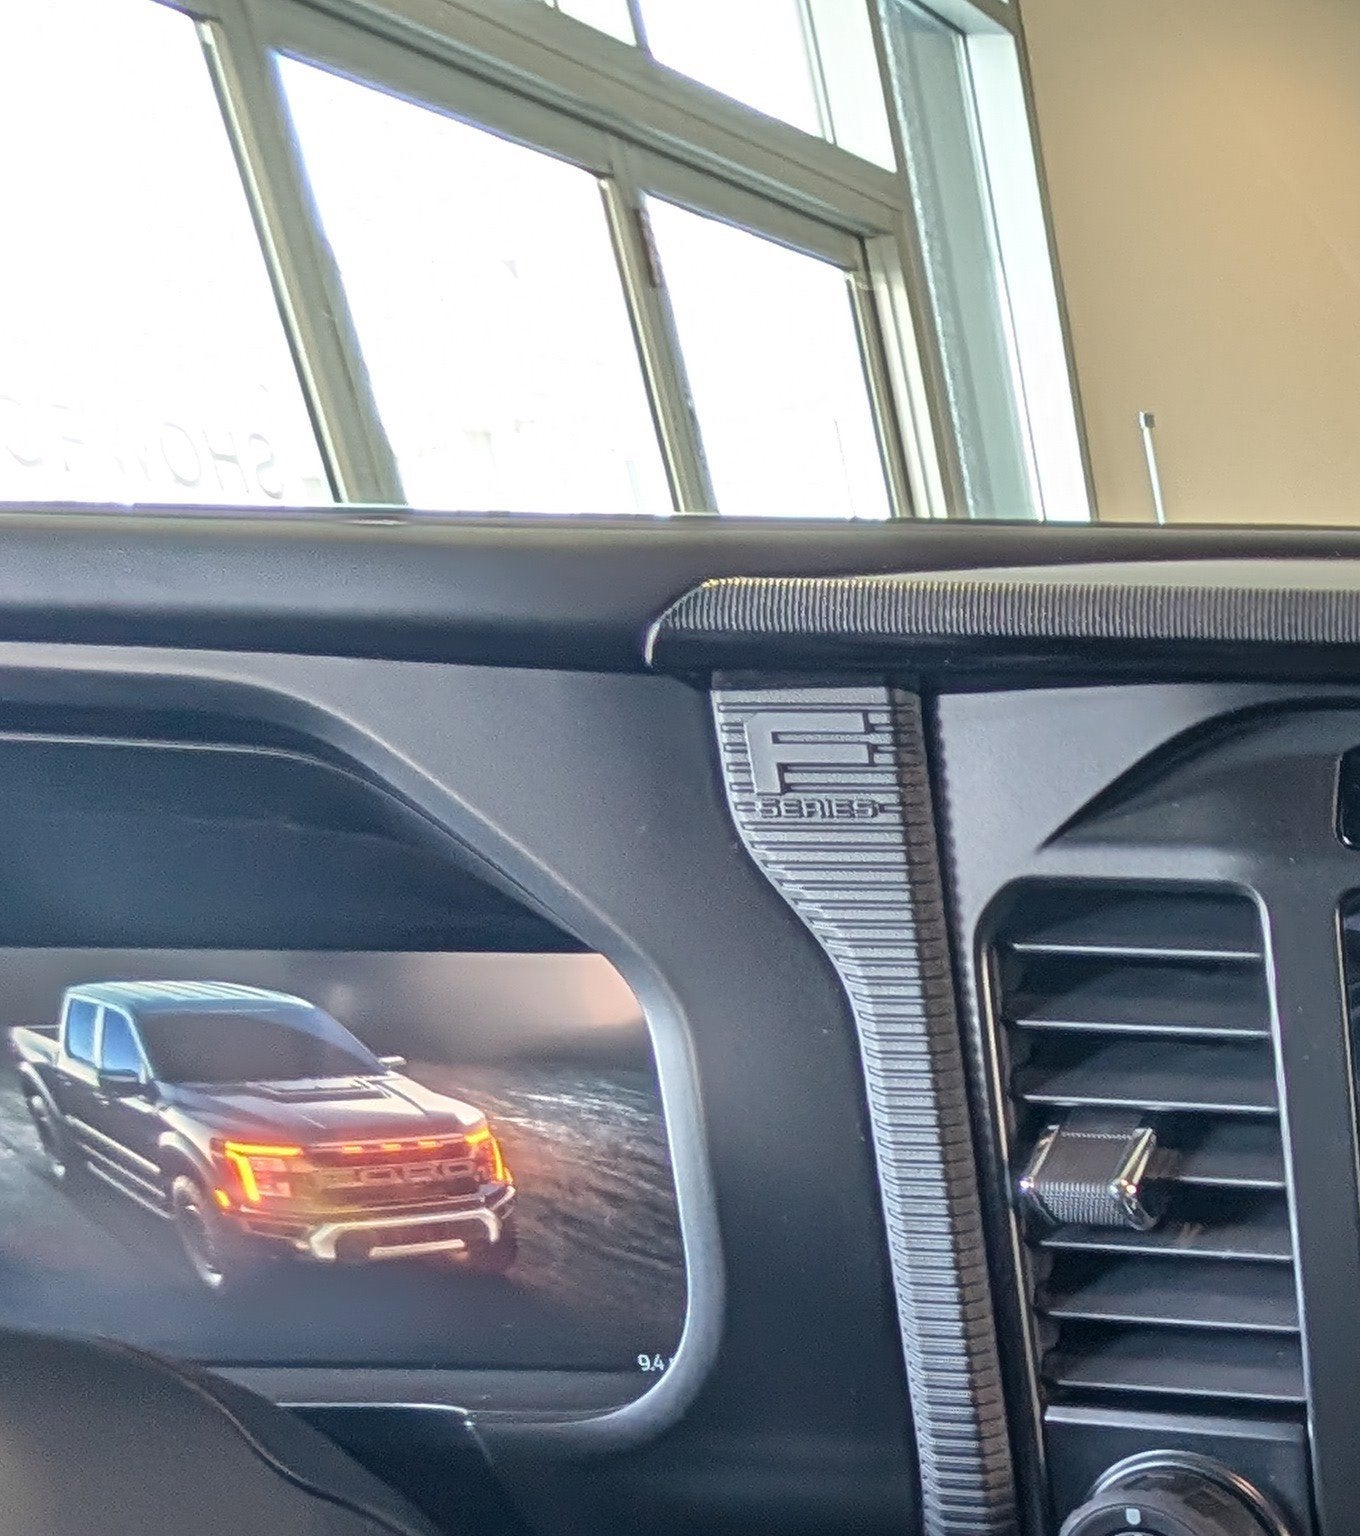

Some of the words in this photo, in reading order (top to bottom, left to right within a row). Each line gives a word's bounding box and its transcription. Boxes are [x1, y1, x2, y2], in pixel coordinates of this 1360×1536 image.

[744, 711, 870, 794] F
[758, 799, 878, 819] SERIES
[637, 1353, 665, 1372] 9.4
